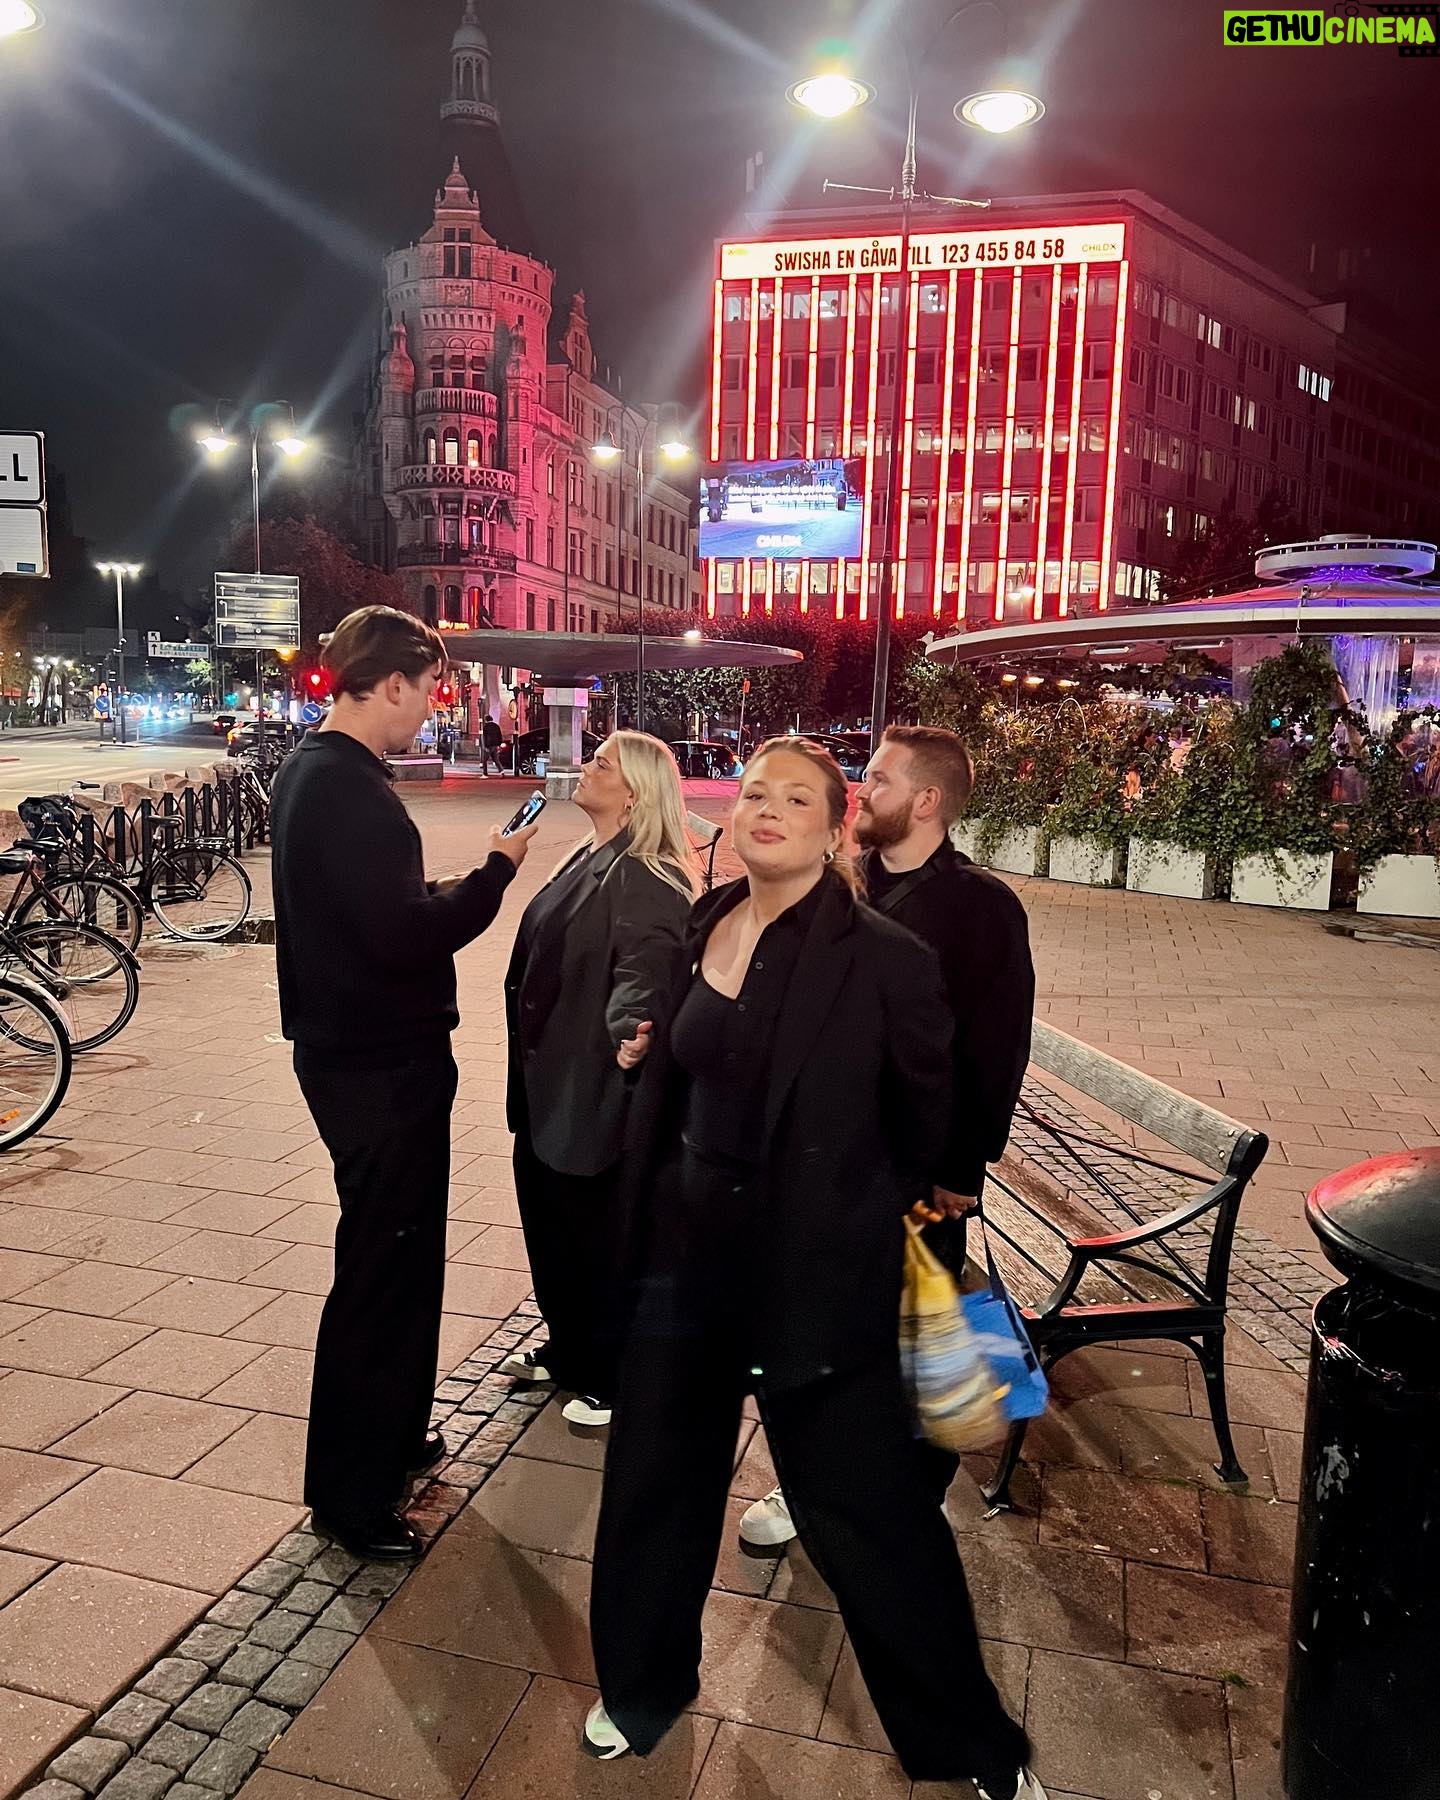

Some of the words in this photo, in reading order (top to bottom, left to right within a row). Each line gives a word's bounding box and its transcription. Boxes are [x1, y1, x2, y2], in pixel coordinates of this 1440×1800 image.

[774, 250, 831, 272] SWISHA
[837, 249, 855, 269] EN
[860, 239, 897, 268] GÅVA
[907, 244, 932, 265] ILL
[941, 243, 970, 264] 123
[975, 241, 1009, 261] 455
[1014, 240, 1036, 260] 84
[1042, 238, 1065, 259] 58
